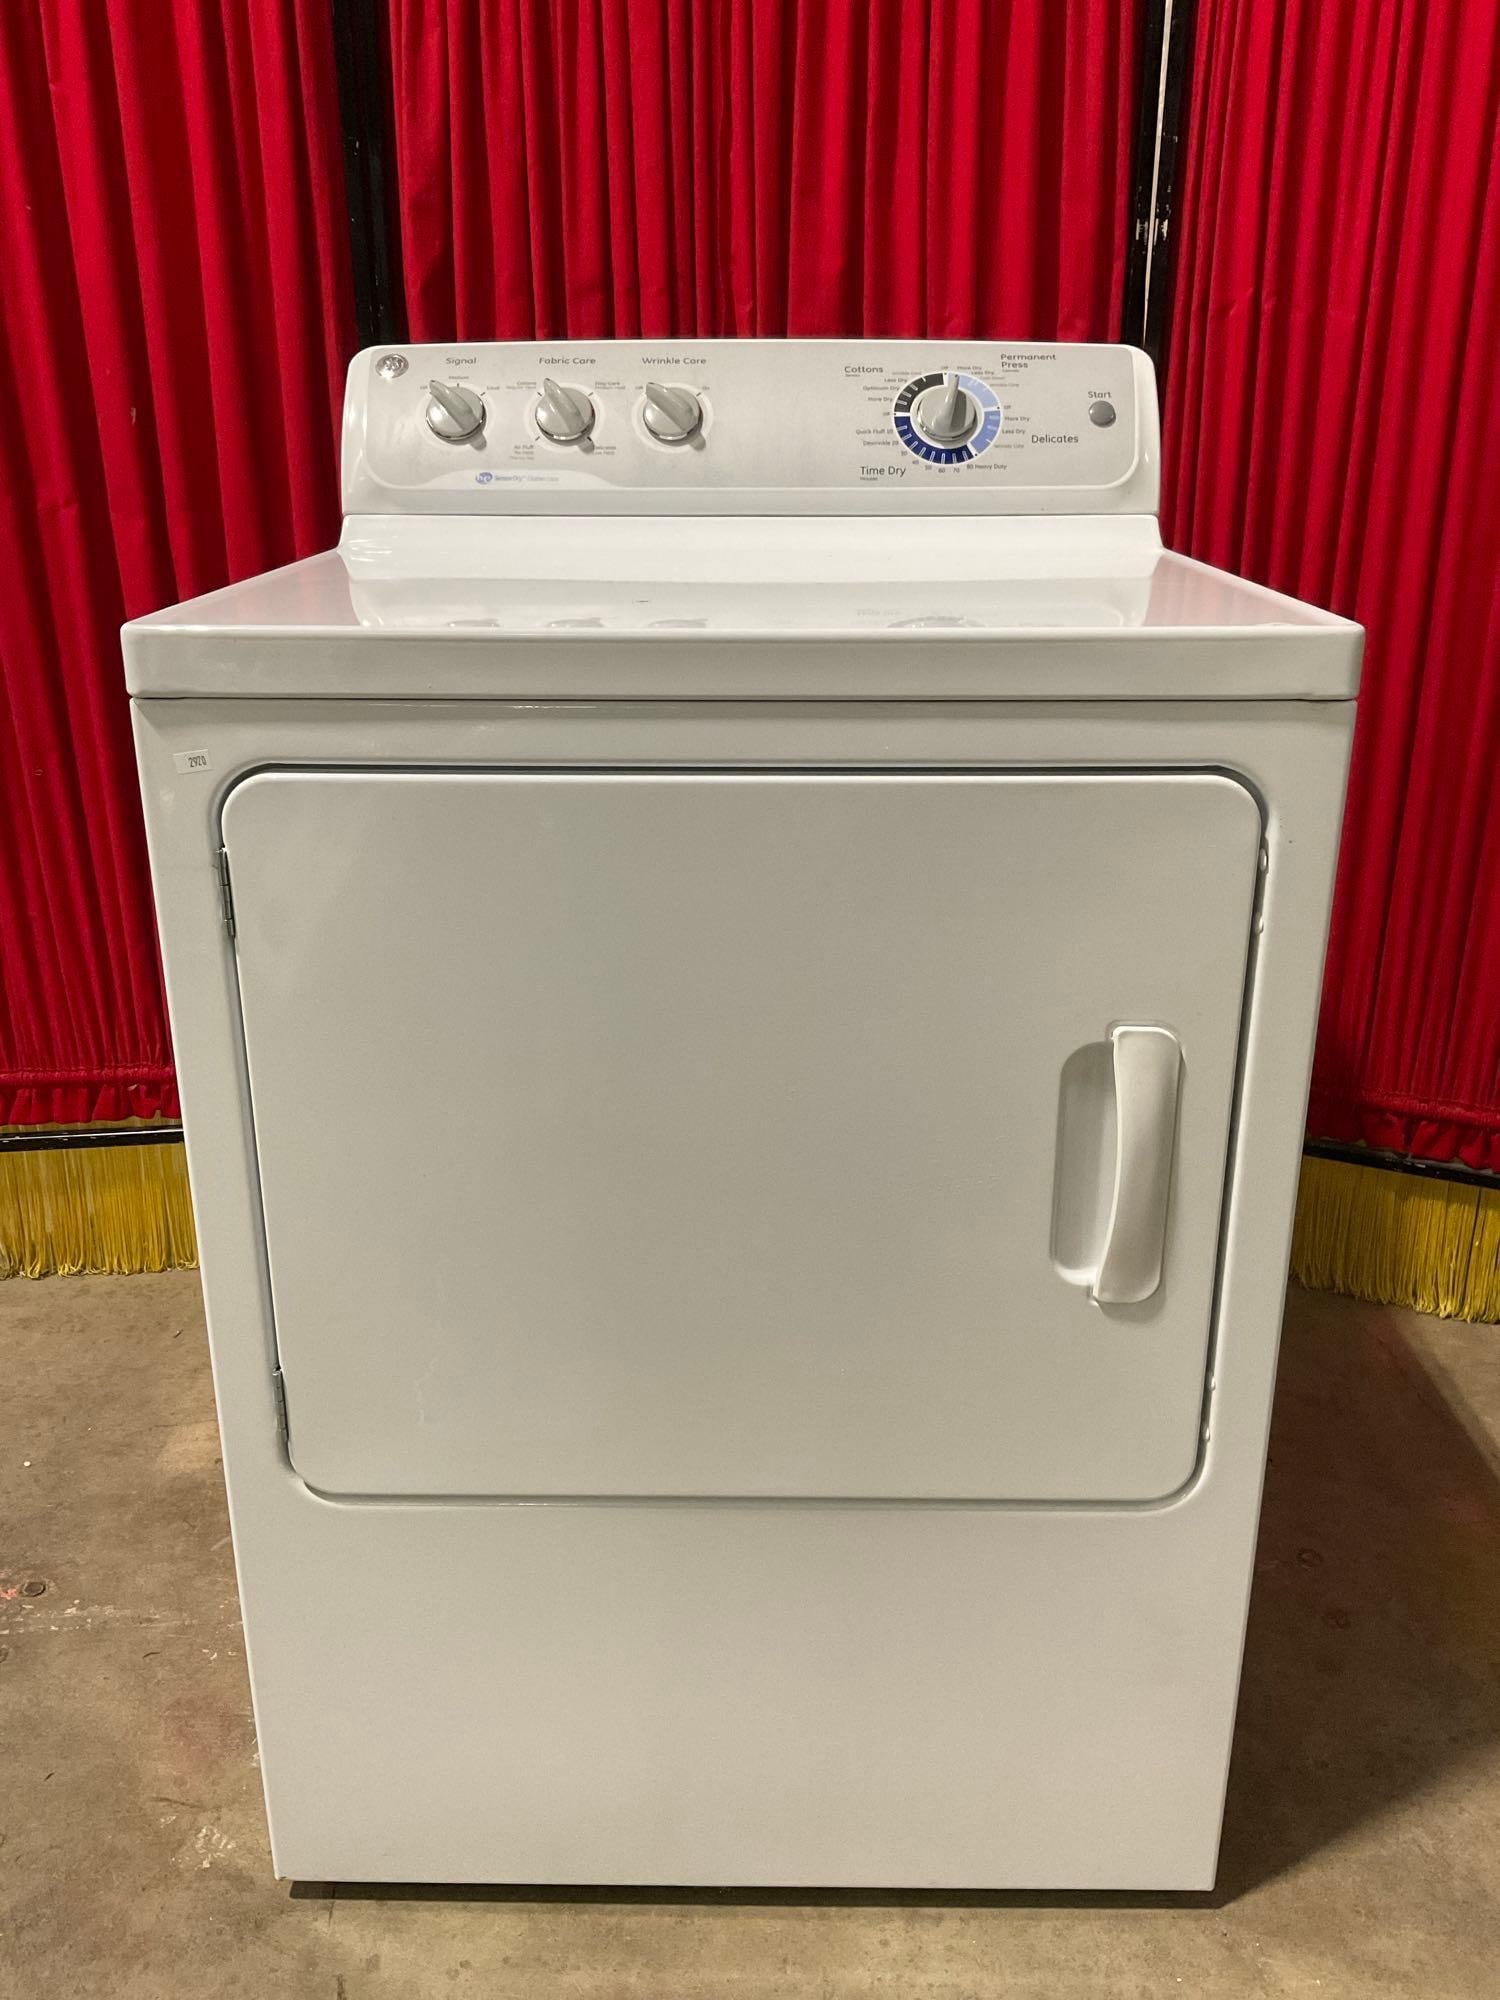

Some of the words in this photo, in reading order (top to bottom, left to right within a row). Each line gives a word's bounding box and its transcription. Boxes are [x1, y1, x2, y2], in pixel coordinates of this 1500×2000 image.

[445, 357, 477, 366] Signal
[538, 356, 570, 365] Fabric
[572, 357, 597, 365] Care
[641, 357, 681, 365] Wrinkle
[683, 357, 707, 365] Care
[1000, 353, 1057, 361] Permanent
[844, 365, 884, 373] Cottons
[1001, 361, 1029, 369] Press
[1087, 390, 1112, 399] Start
[1031, 434, 1079, 444] Delicates
[860, 466, 885, 475] Time
[888, 466, 906, 477] Dry
